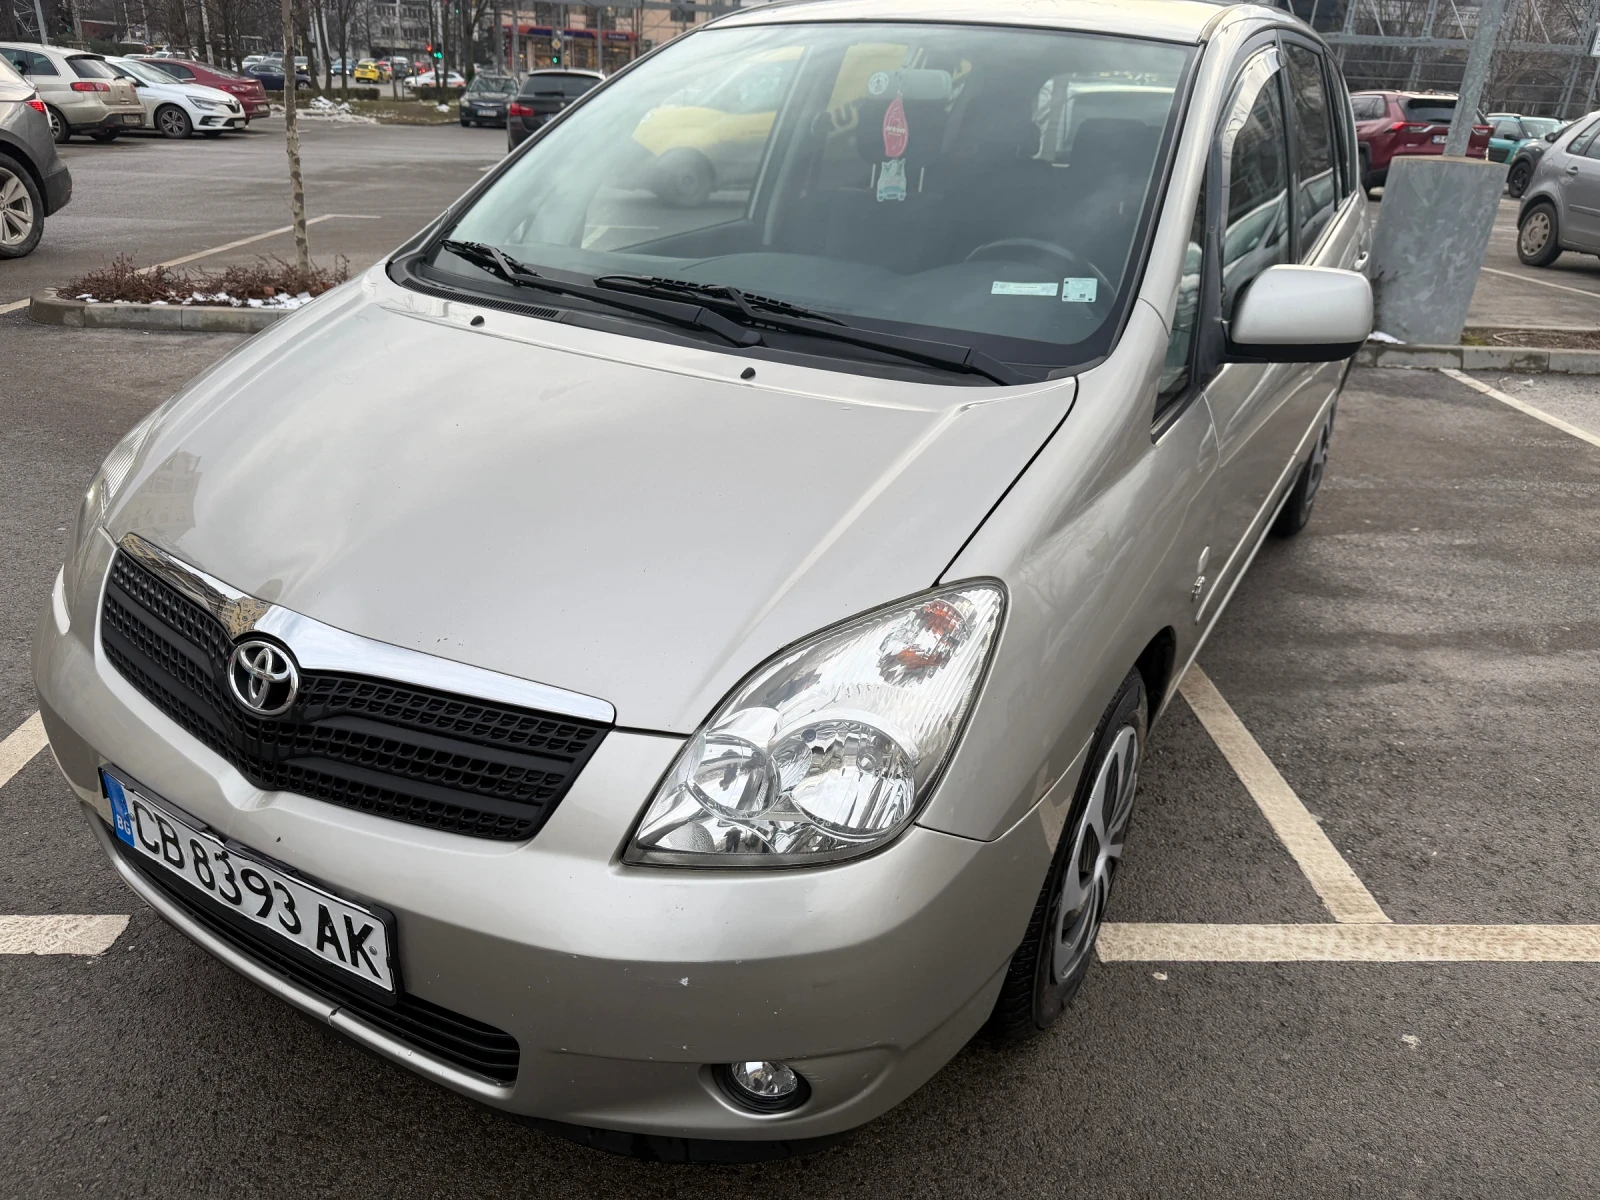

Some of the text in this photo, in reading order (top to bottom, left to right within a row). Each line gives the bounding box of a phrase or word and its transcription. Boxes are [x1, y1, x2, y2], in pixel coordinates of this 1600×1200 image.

[116, 813, 131, 836] BG
[131, 799, 382, 980] CB 8393 AK
